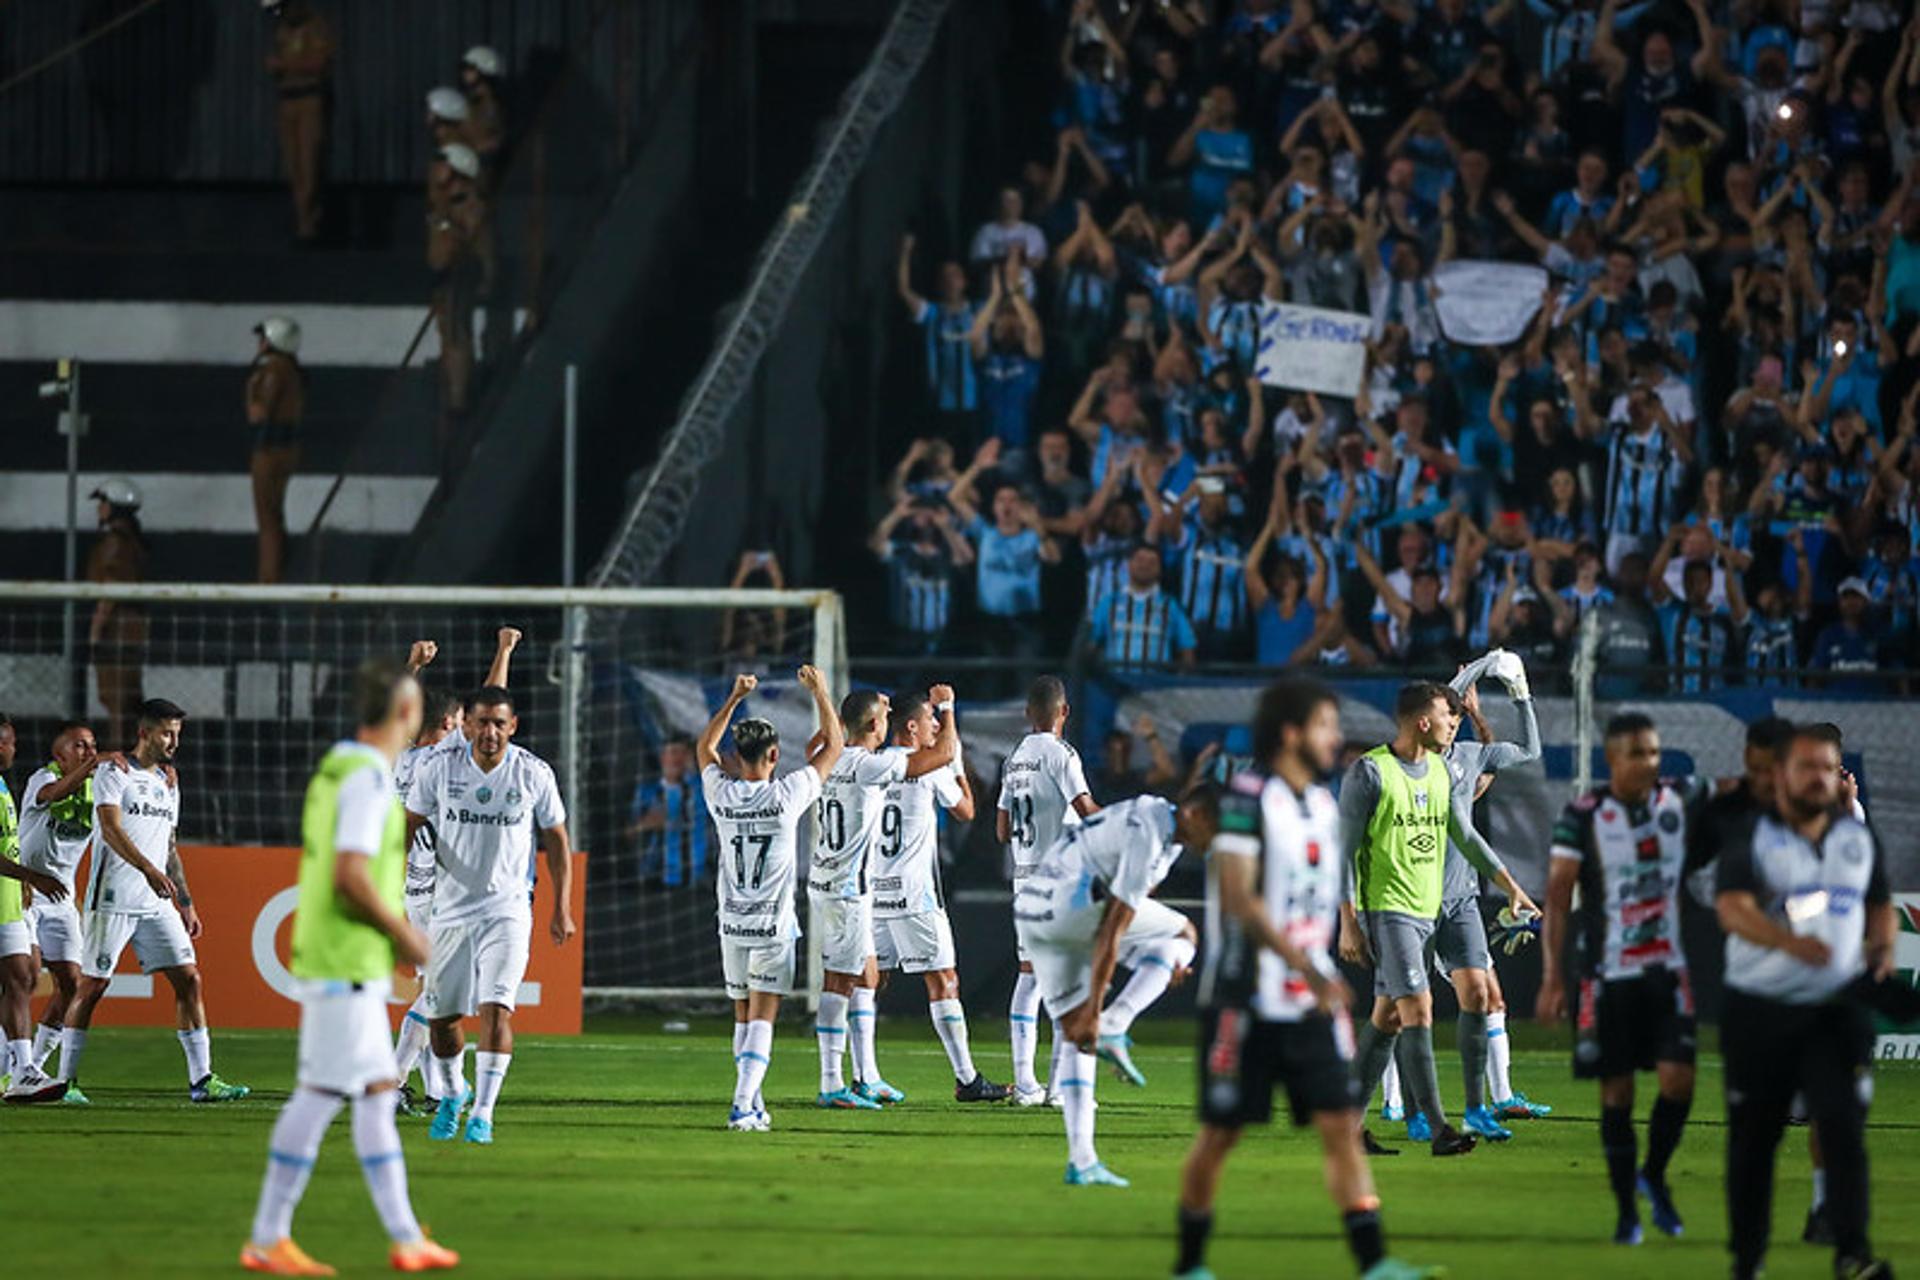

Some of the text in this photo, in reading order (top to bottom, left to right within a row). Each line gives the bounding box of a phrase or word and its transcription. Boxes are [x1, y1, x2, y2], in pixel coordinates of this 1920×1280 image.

[881, 803, 902, 858] 9
[731, 835, 772, 890] 17
[723, 923, 777, 938] Unimed
